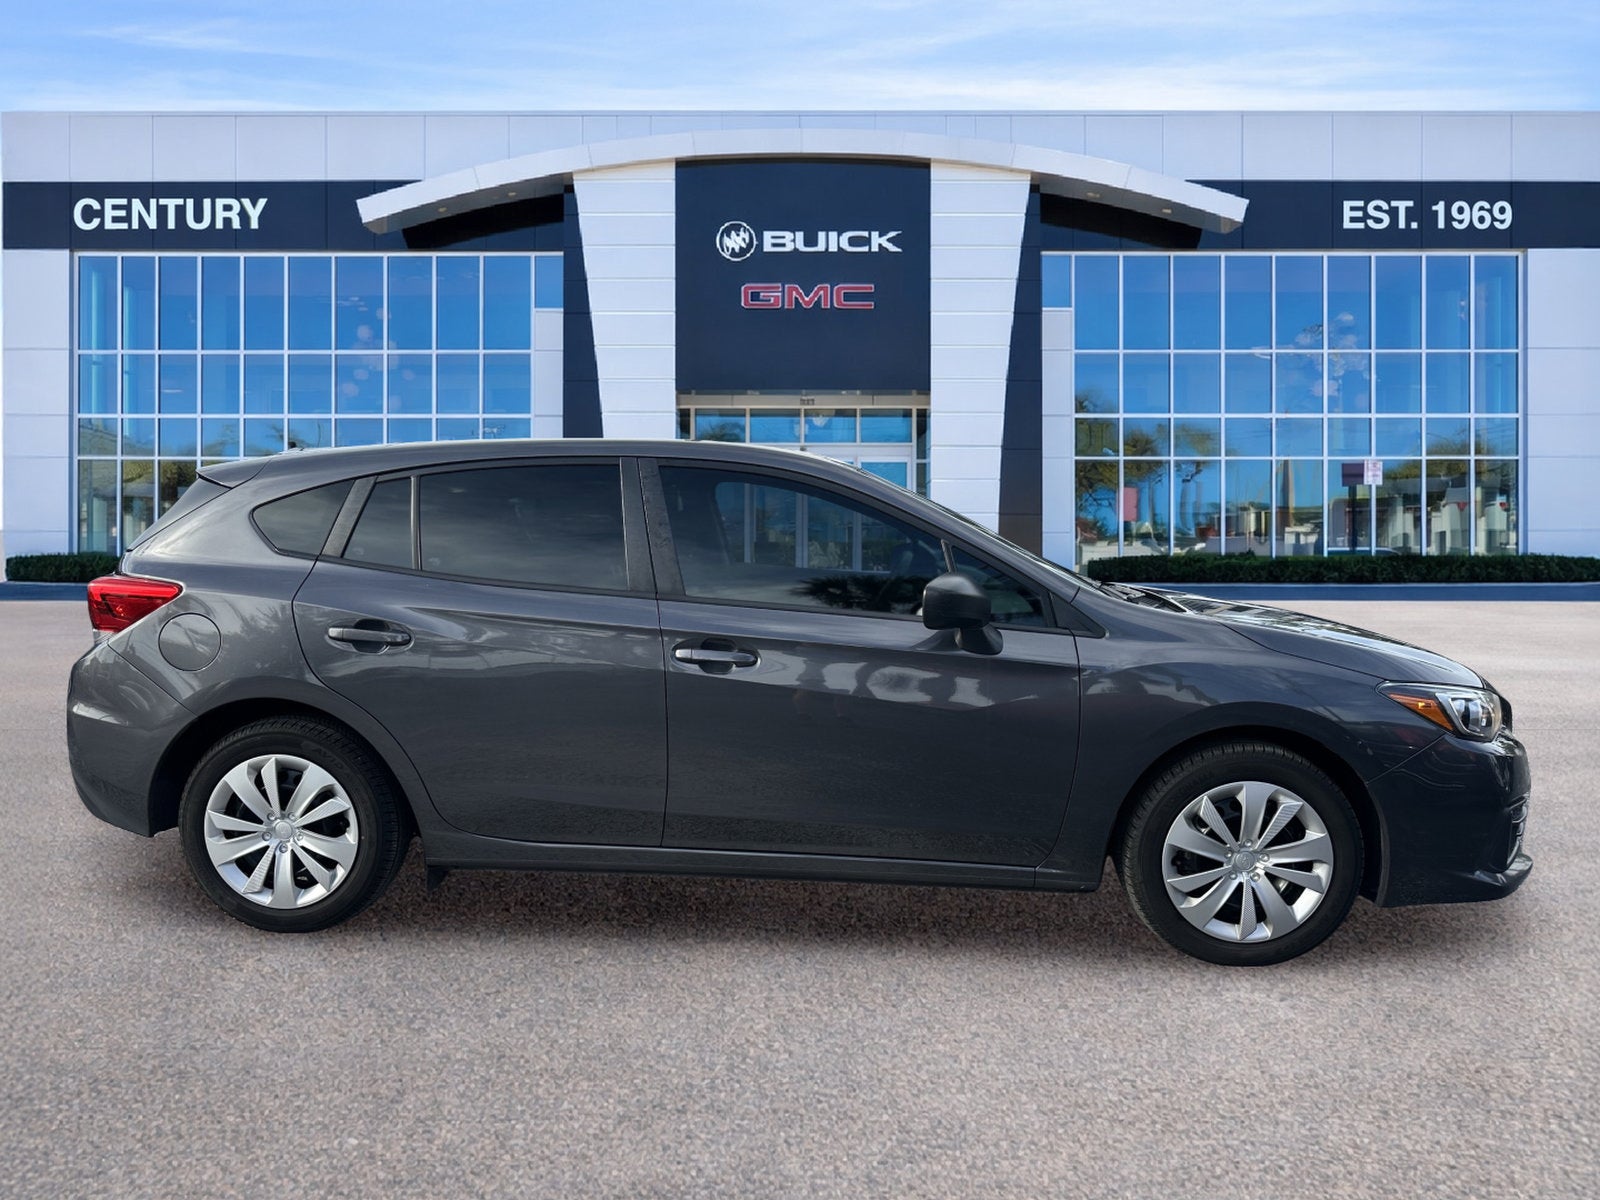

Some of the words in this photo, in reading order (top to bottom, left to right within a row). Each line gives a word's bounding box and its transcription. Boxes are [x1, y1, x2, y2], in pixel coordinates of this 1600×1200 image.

[73, 197, 268, 231] CENTURY
[1342, 199, 1419, 230] EST.
[1431, 200, 1513, 230] 1969
[762, 230, 903, 253] BUICK
[740, 282, 875, 310] GMC
